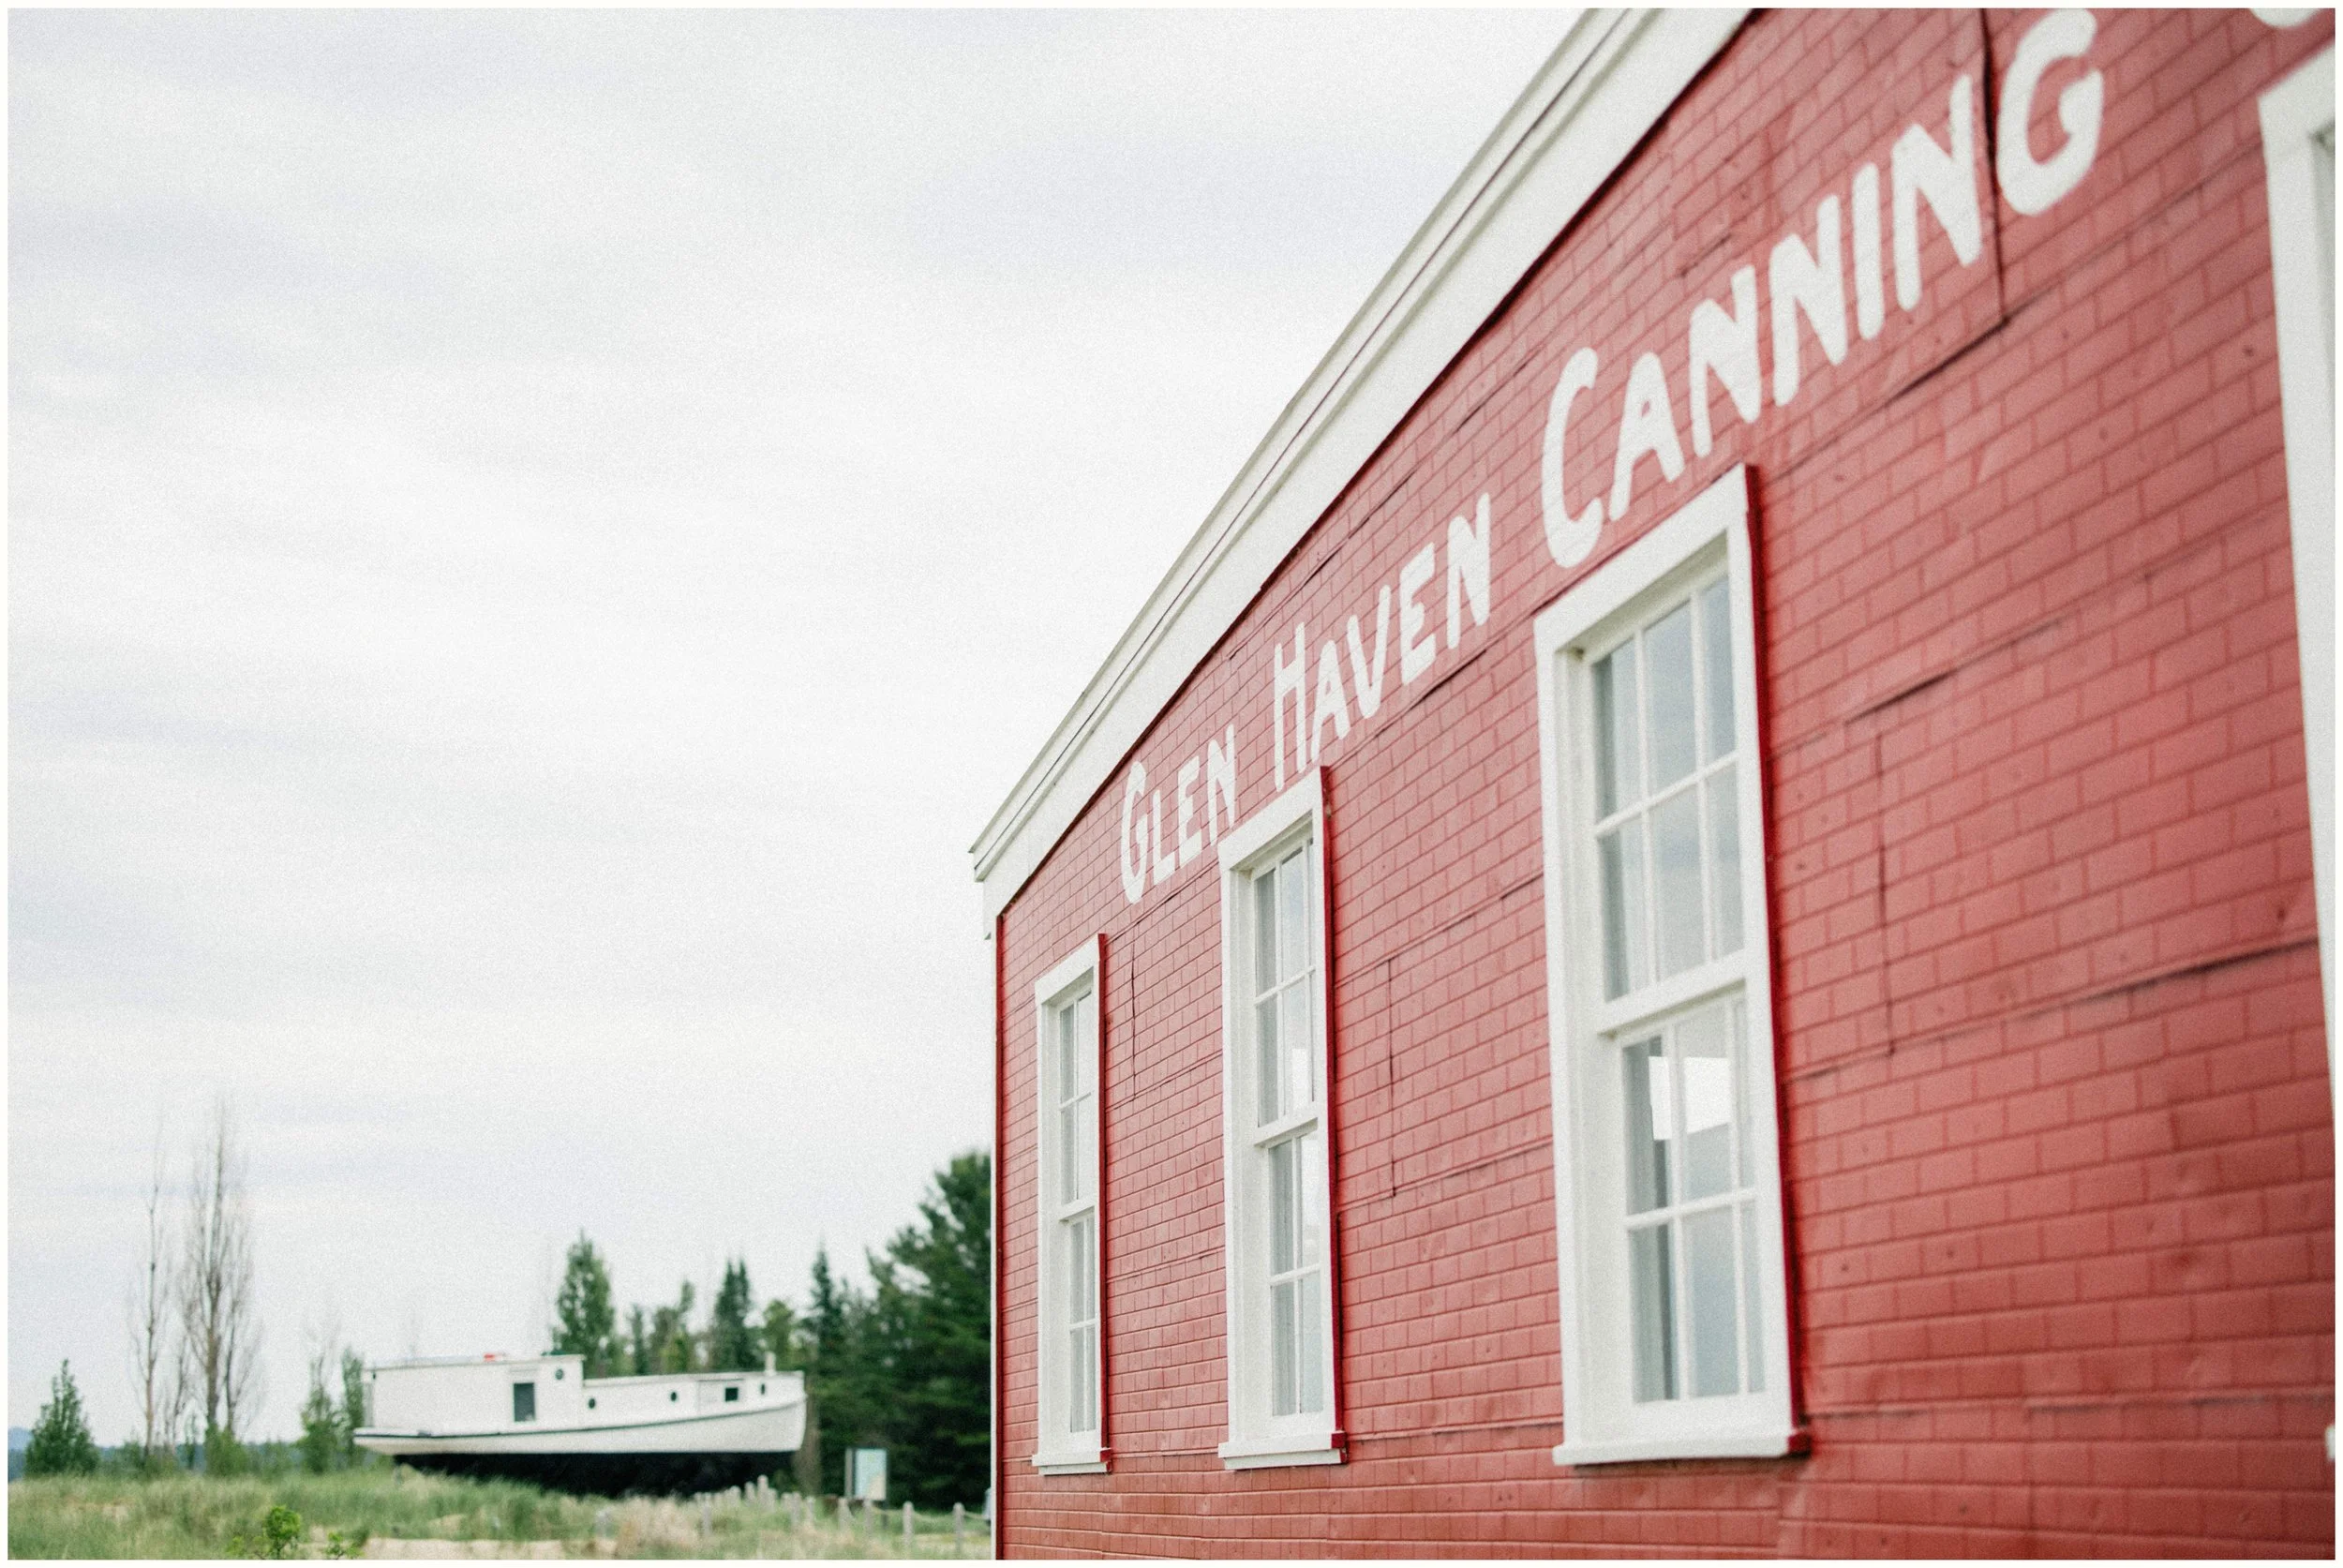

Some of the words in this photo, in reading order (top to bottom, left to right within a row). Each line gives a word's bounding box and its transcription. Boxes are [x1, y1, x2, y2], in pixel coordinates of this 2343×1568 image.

[1121, 724, 1236, 904] GLEN
[1274, 493, 1490, 792] HAVEN
[1542, 8, 2103, 568] CANNING
